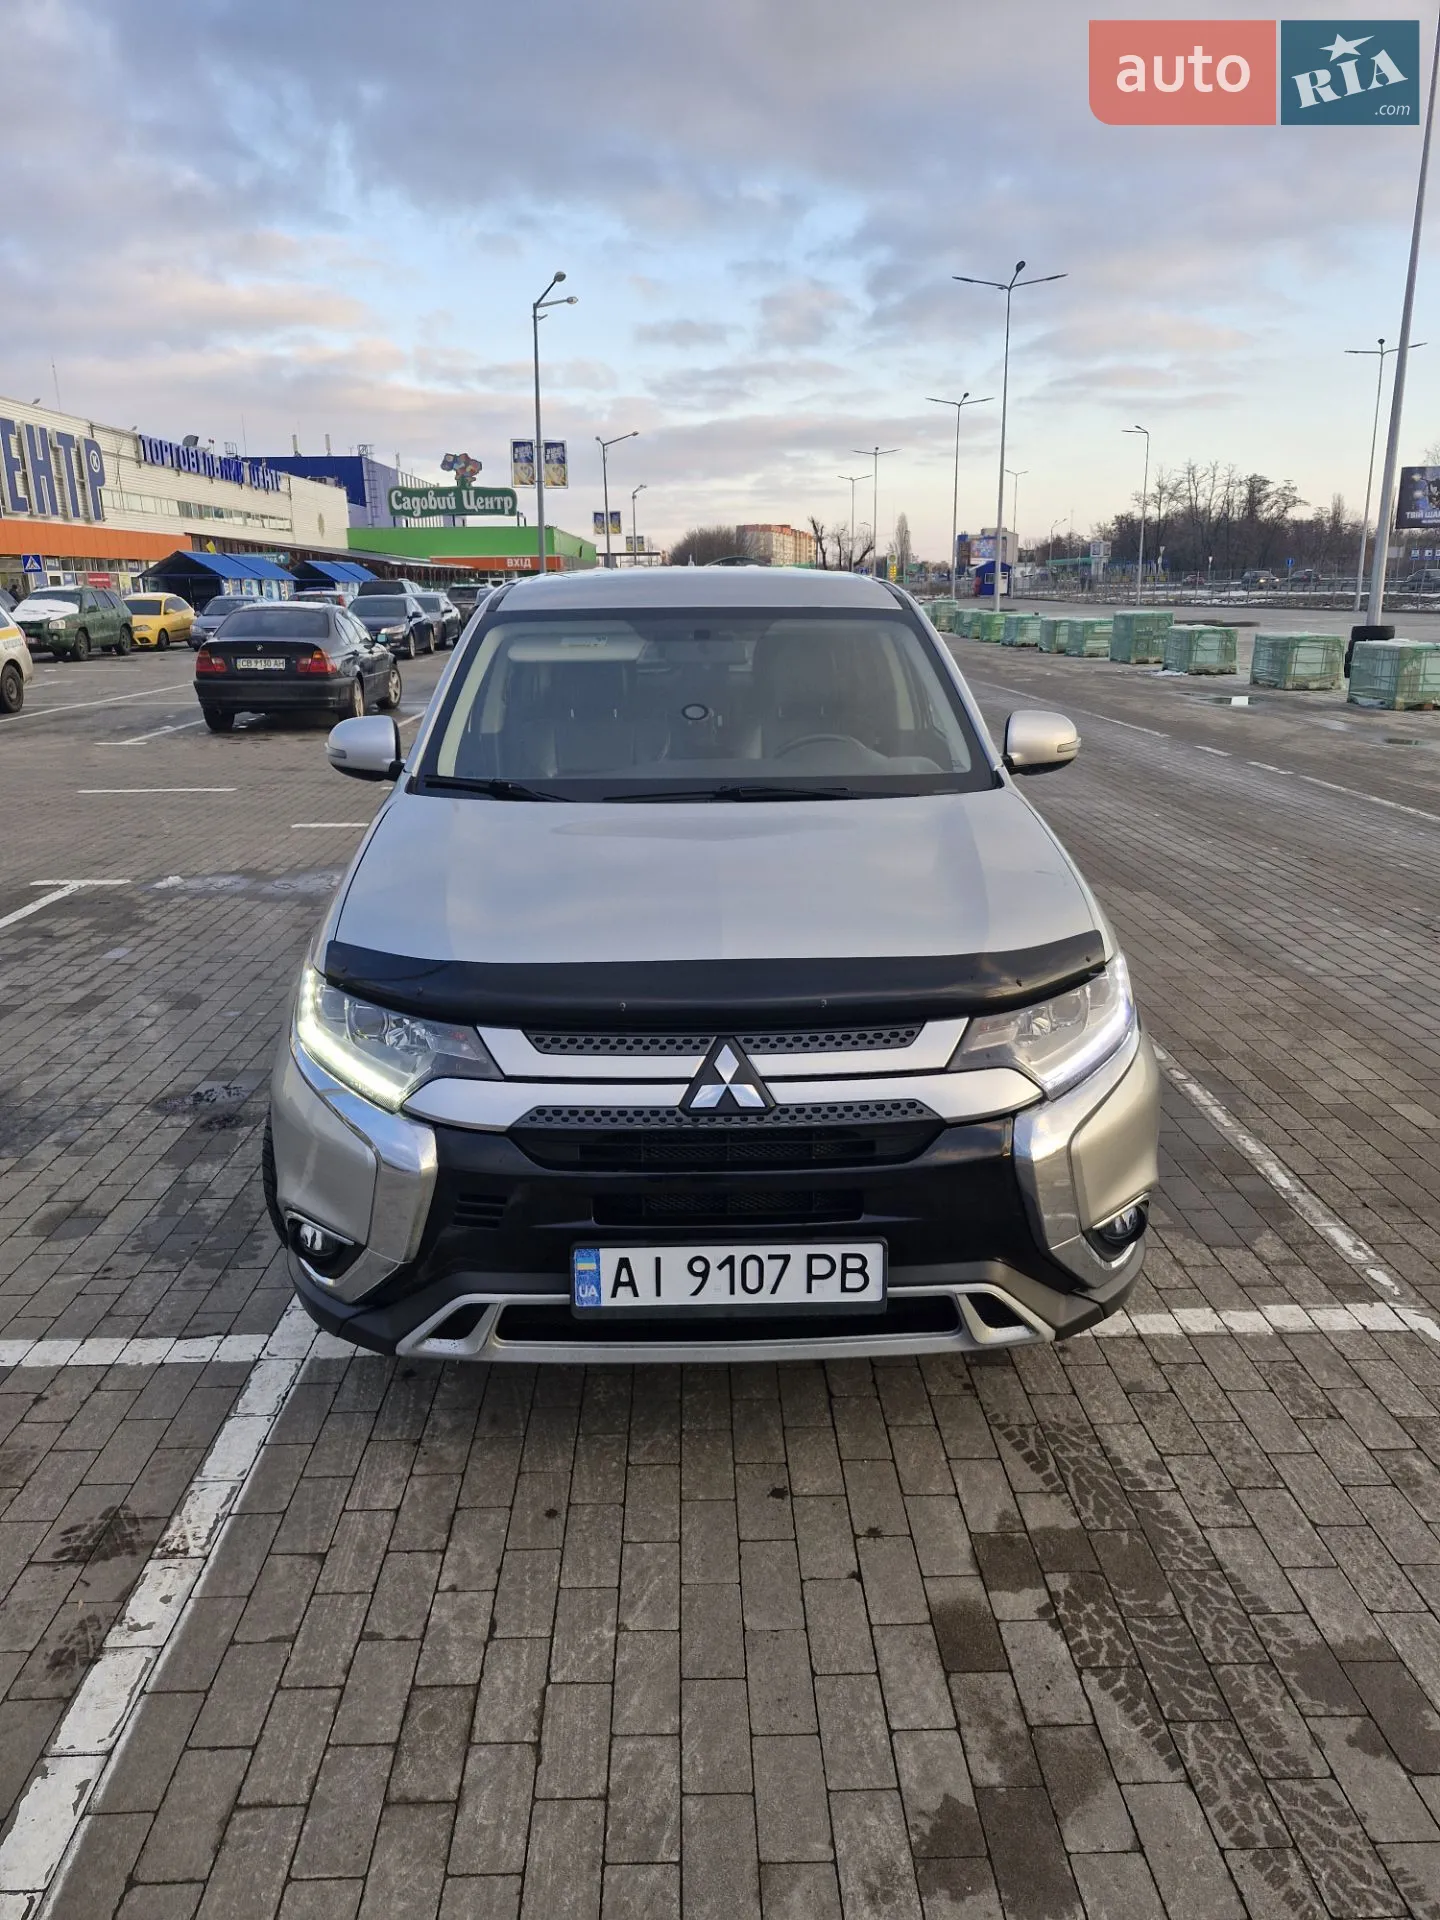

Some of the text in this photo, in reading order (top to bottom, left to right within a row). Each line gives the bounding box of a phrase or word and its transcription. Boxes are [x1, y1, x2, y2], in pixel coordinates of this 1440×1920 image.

[0, 417, 105, 521] ЕНТР
[390, 489, 513, 517] Садовий Центр
[506, 557, 532, 569] ВХІД
[610, 1252, 870, 1298] AI 9107 PB
[578, 1284, 600, 1298] UA
